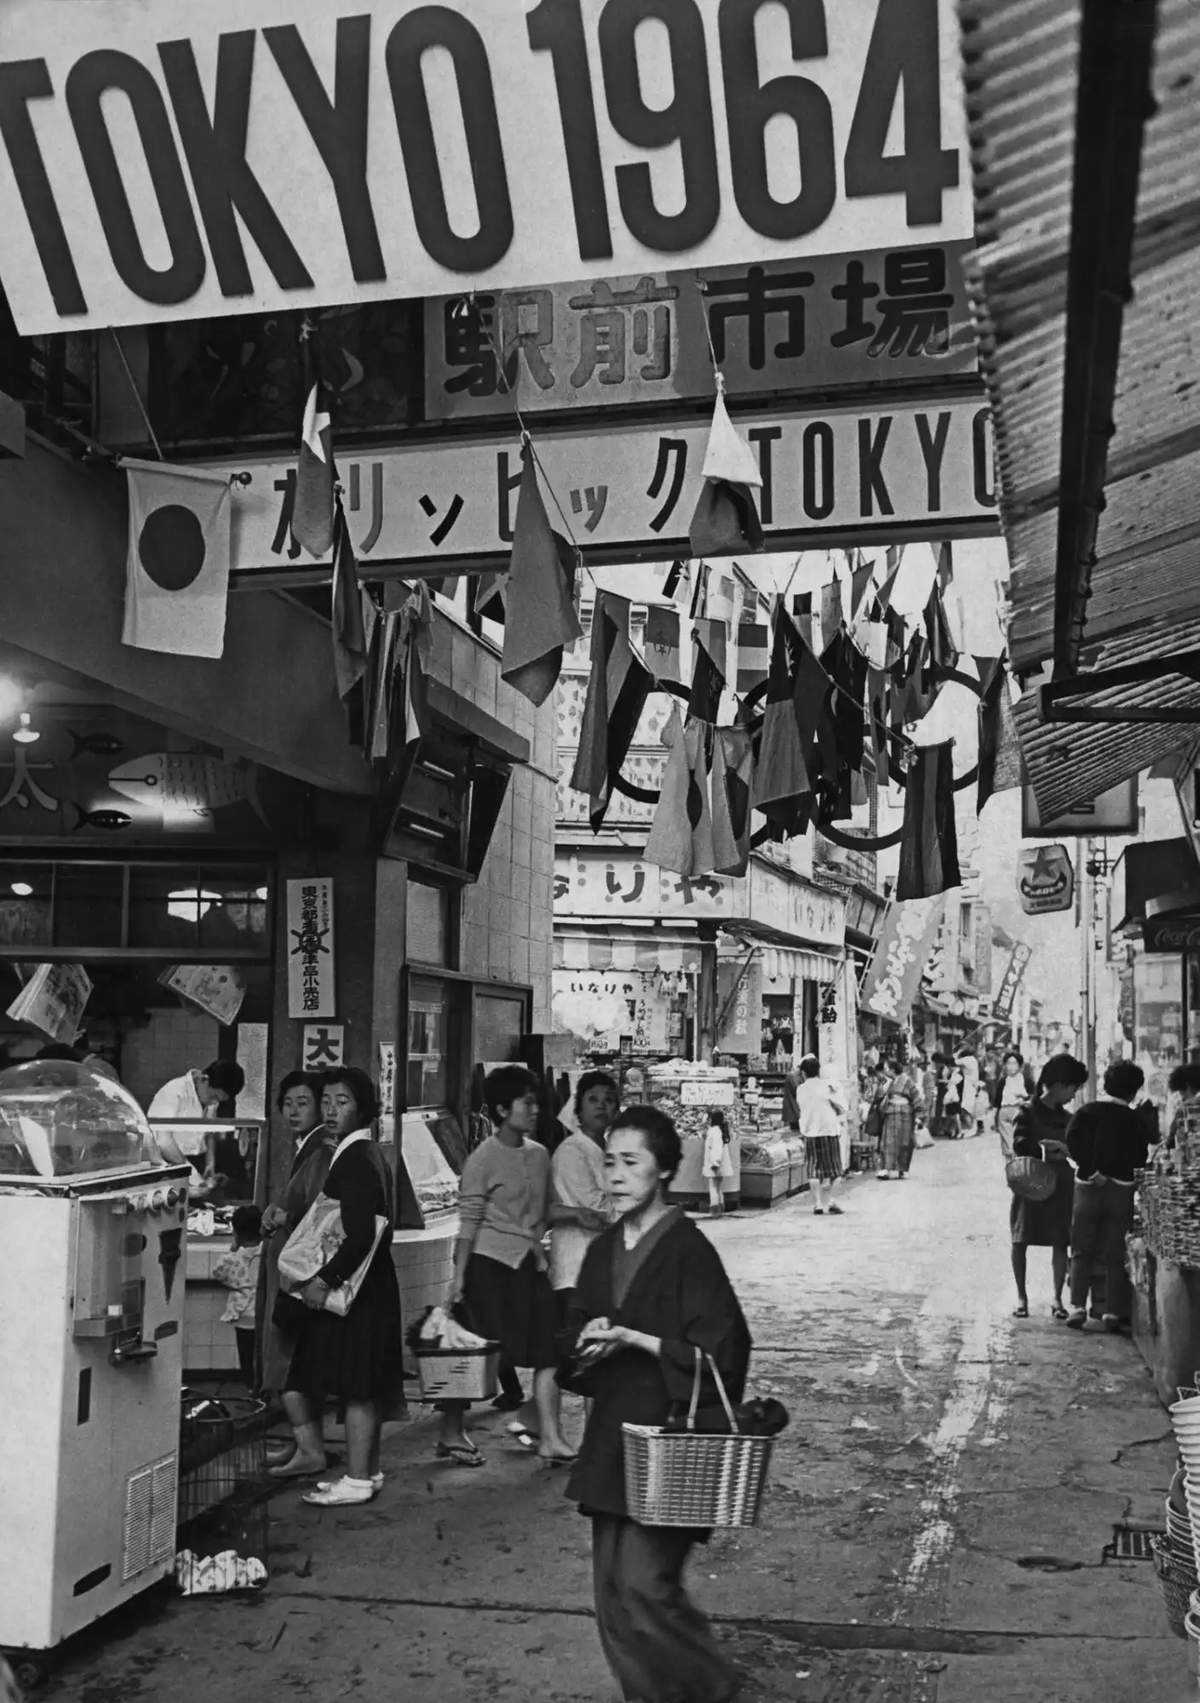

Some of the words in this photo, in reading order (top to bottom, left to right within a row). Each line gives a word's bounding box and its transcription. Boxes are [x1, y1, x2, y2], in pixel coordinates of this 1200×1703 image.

[0, 5, 514, 316] TOKYO
[527, 0, 960, 260] 1964
[443, 250, 955, 397] 駅前市場
